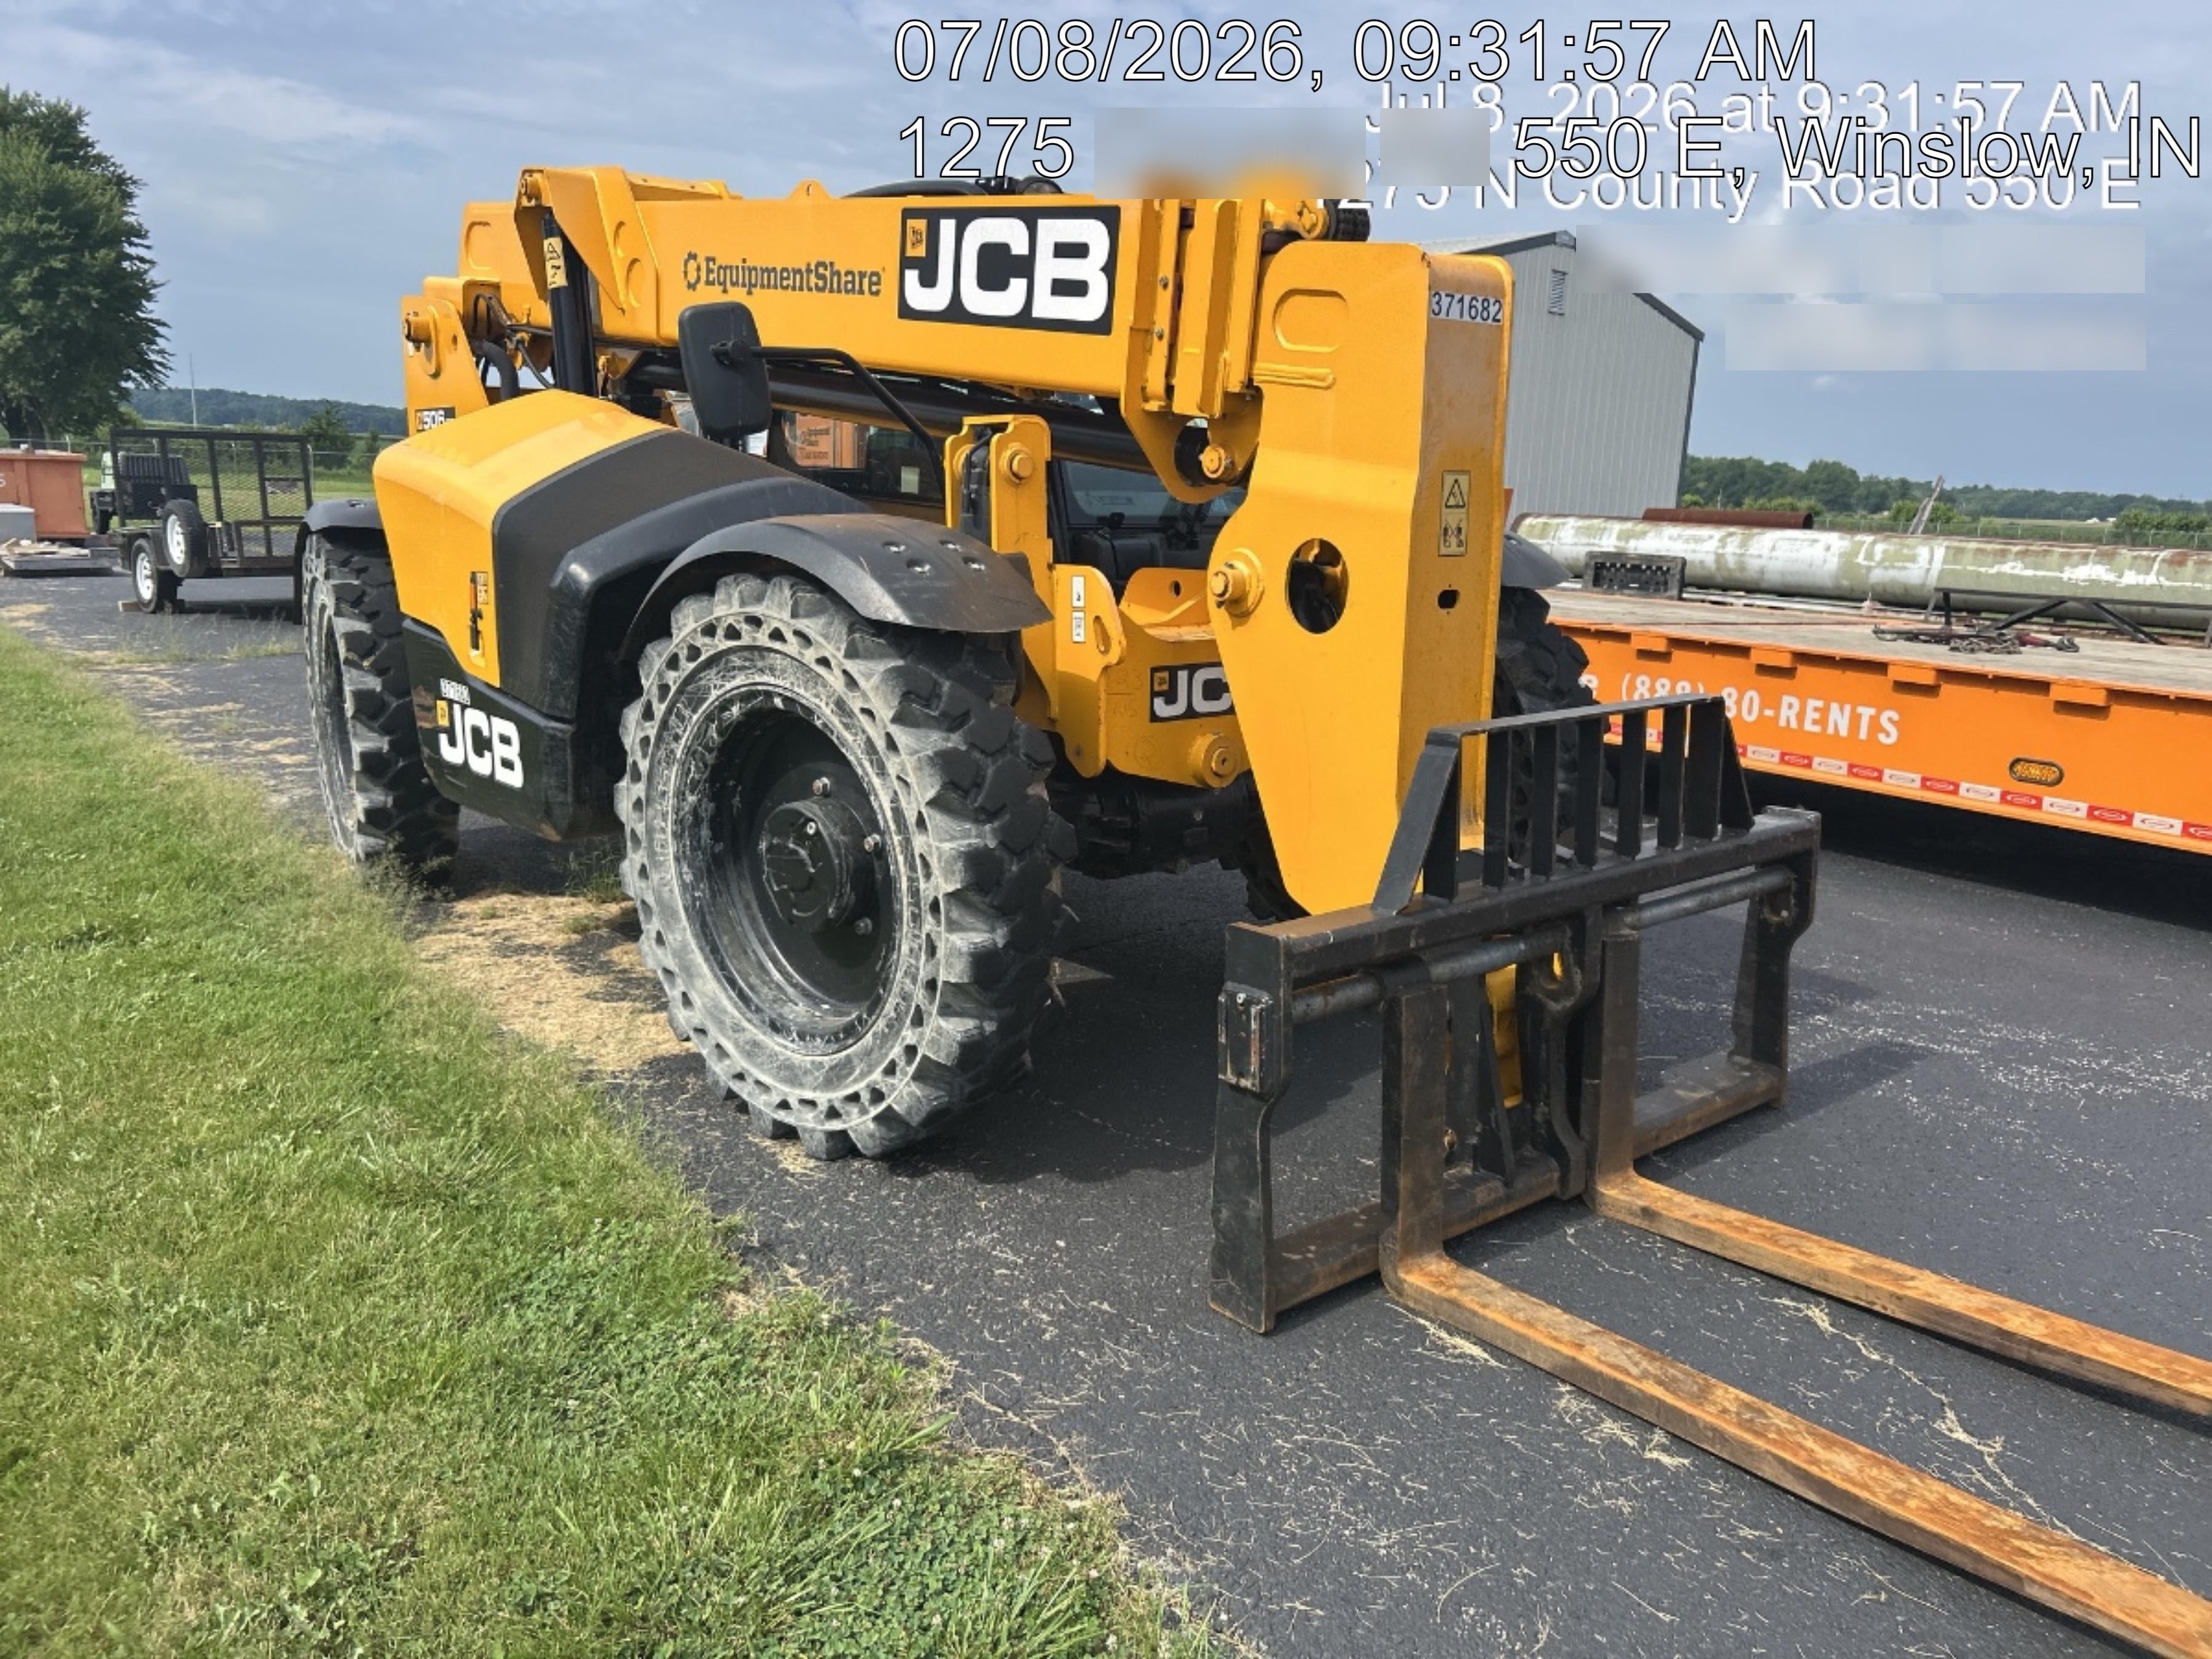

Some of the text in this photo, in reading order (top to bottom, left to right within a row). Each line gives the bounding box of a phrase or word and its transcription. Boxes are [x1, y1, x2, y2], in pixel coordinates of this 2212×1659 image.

[704, 256, 882, 297] EquipmentShare
[904, 216, 1111, 322] JCB
[1432, 291, 1502, 323] 371682
[1153, 666, 1232, 718] JC
[1721, 686, 1901, 745] 80-RENTS
[438, 703, 524, 788] JCB
